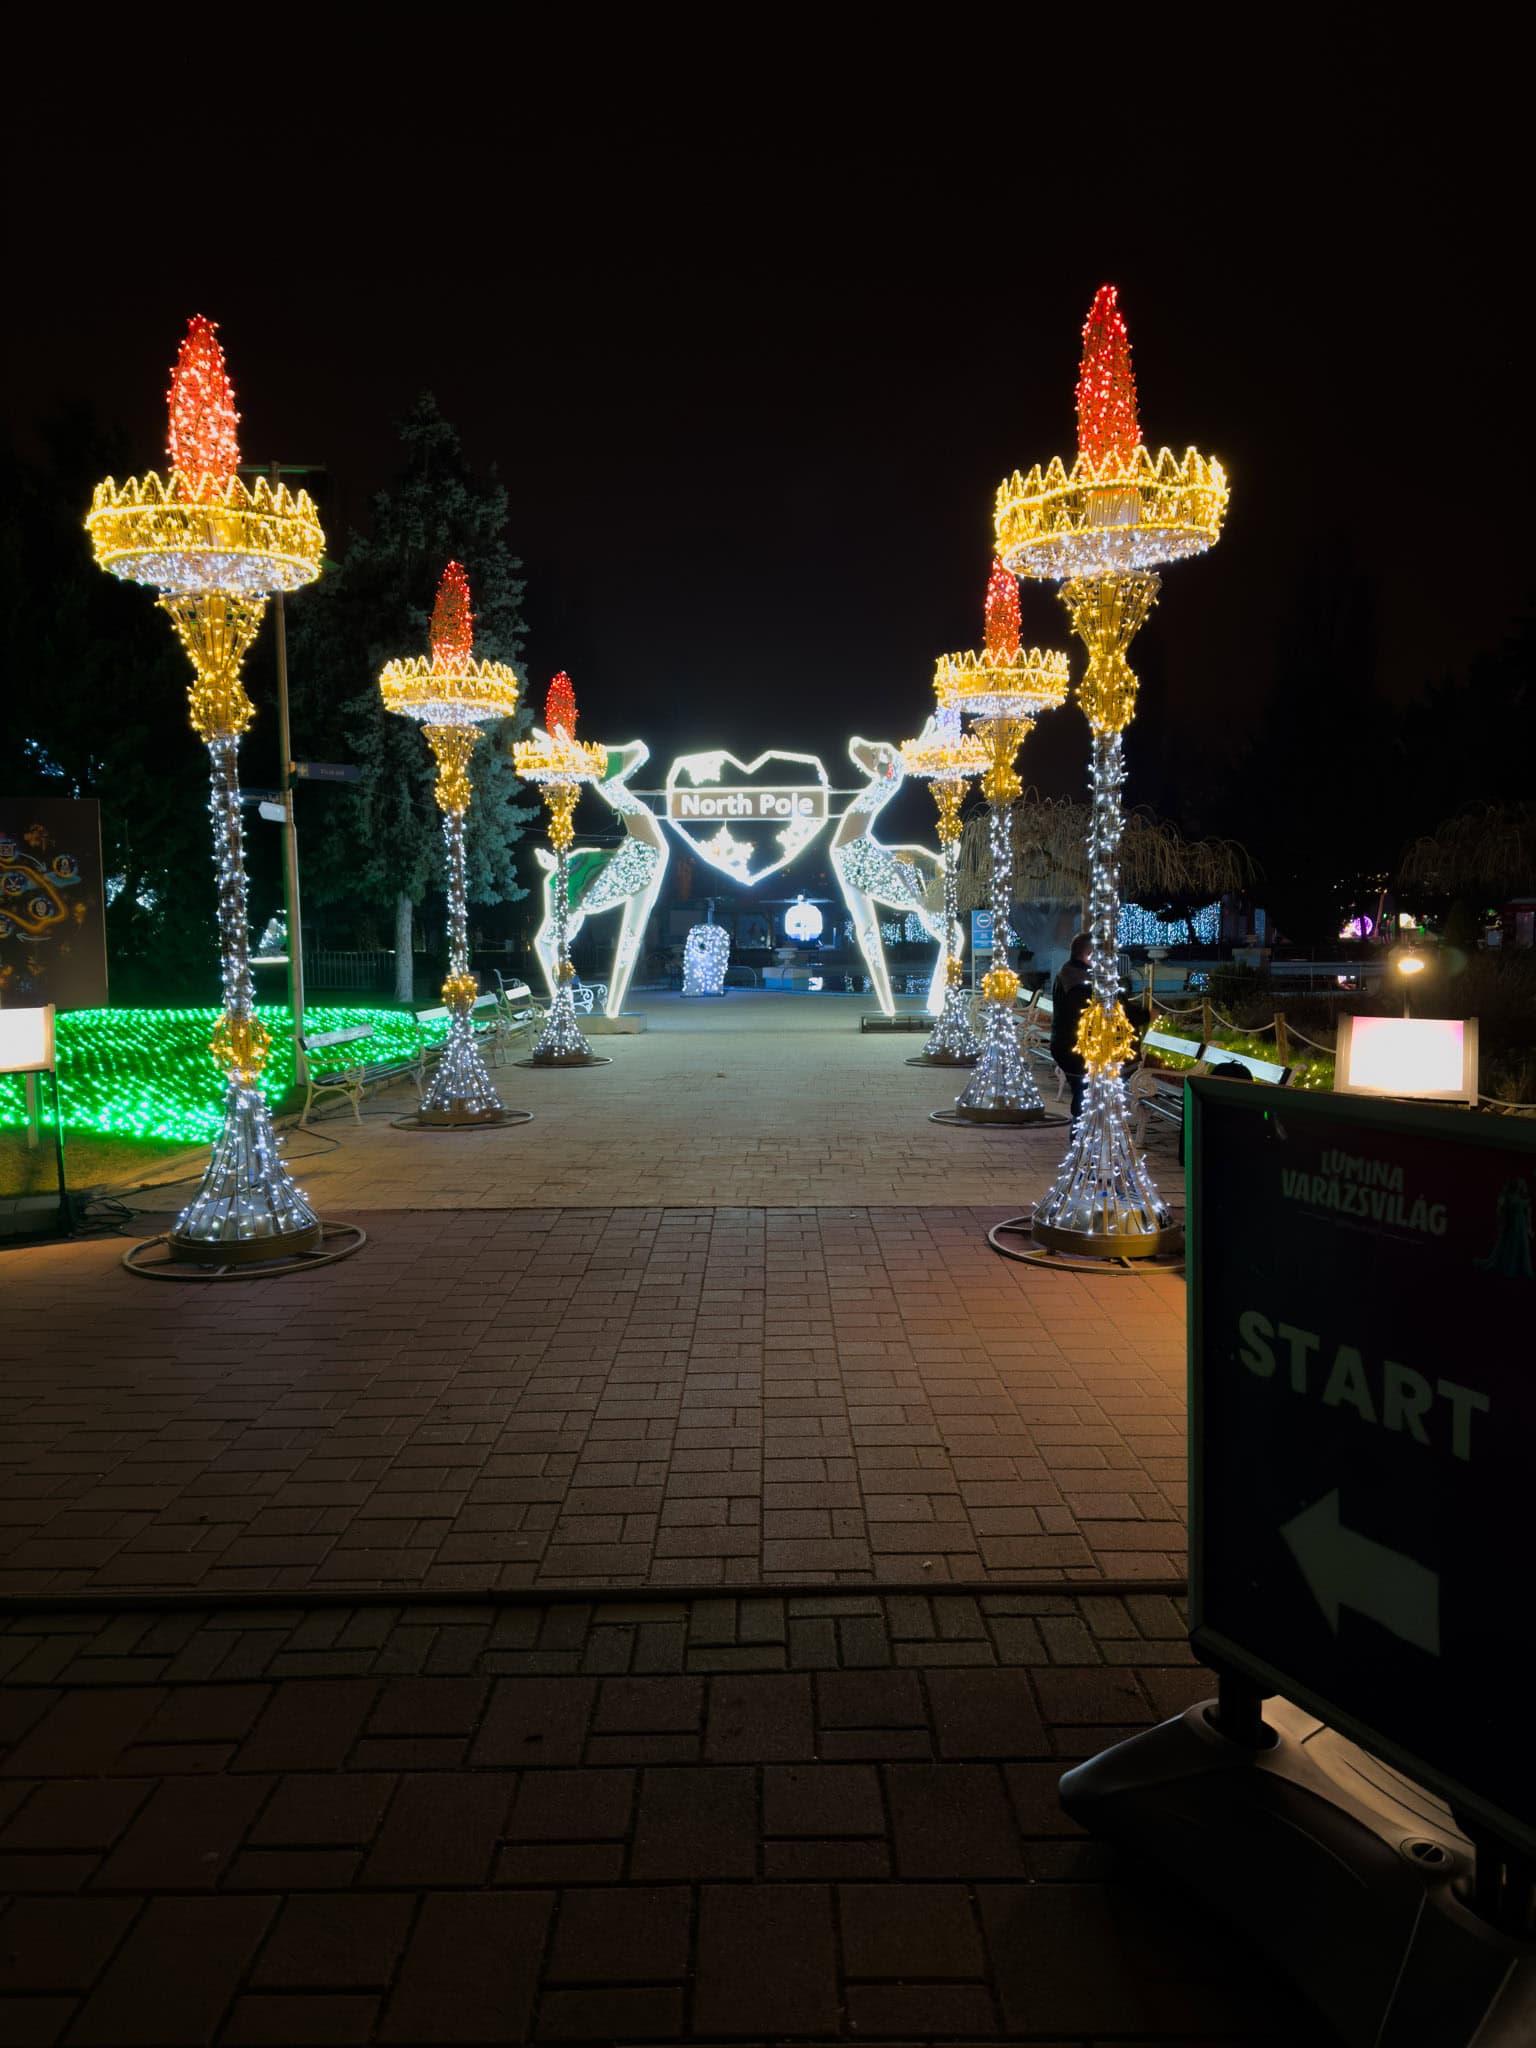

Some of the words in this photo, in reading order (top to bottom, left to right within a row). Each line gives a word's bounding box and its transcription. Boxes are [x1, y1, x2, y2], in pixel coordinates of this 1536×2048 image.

[681, 793, 752, 815] North
[759, 792, 813, 815] Pole
[1320, 1148, 1404, 1193] LUMINA
[1281, 1168, 1448, 1235] VARÁZSVILÁG
[1239, 1310, 1490, 1462] START
